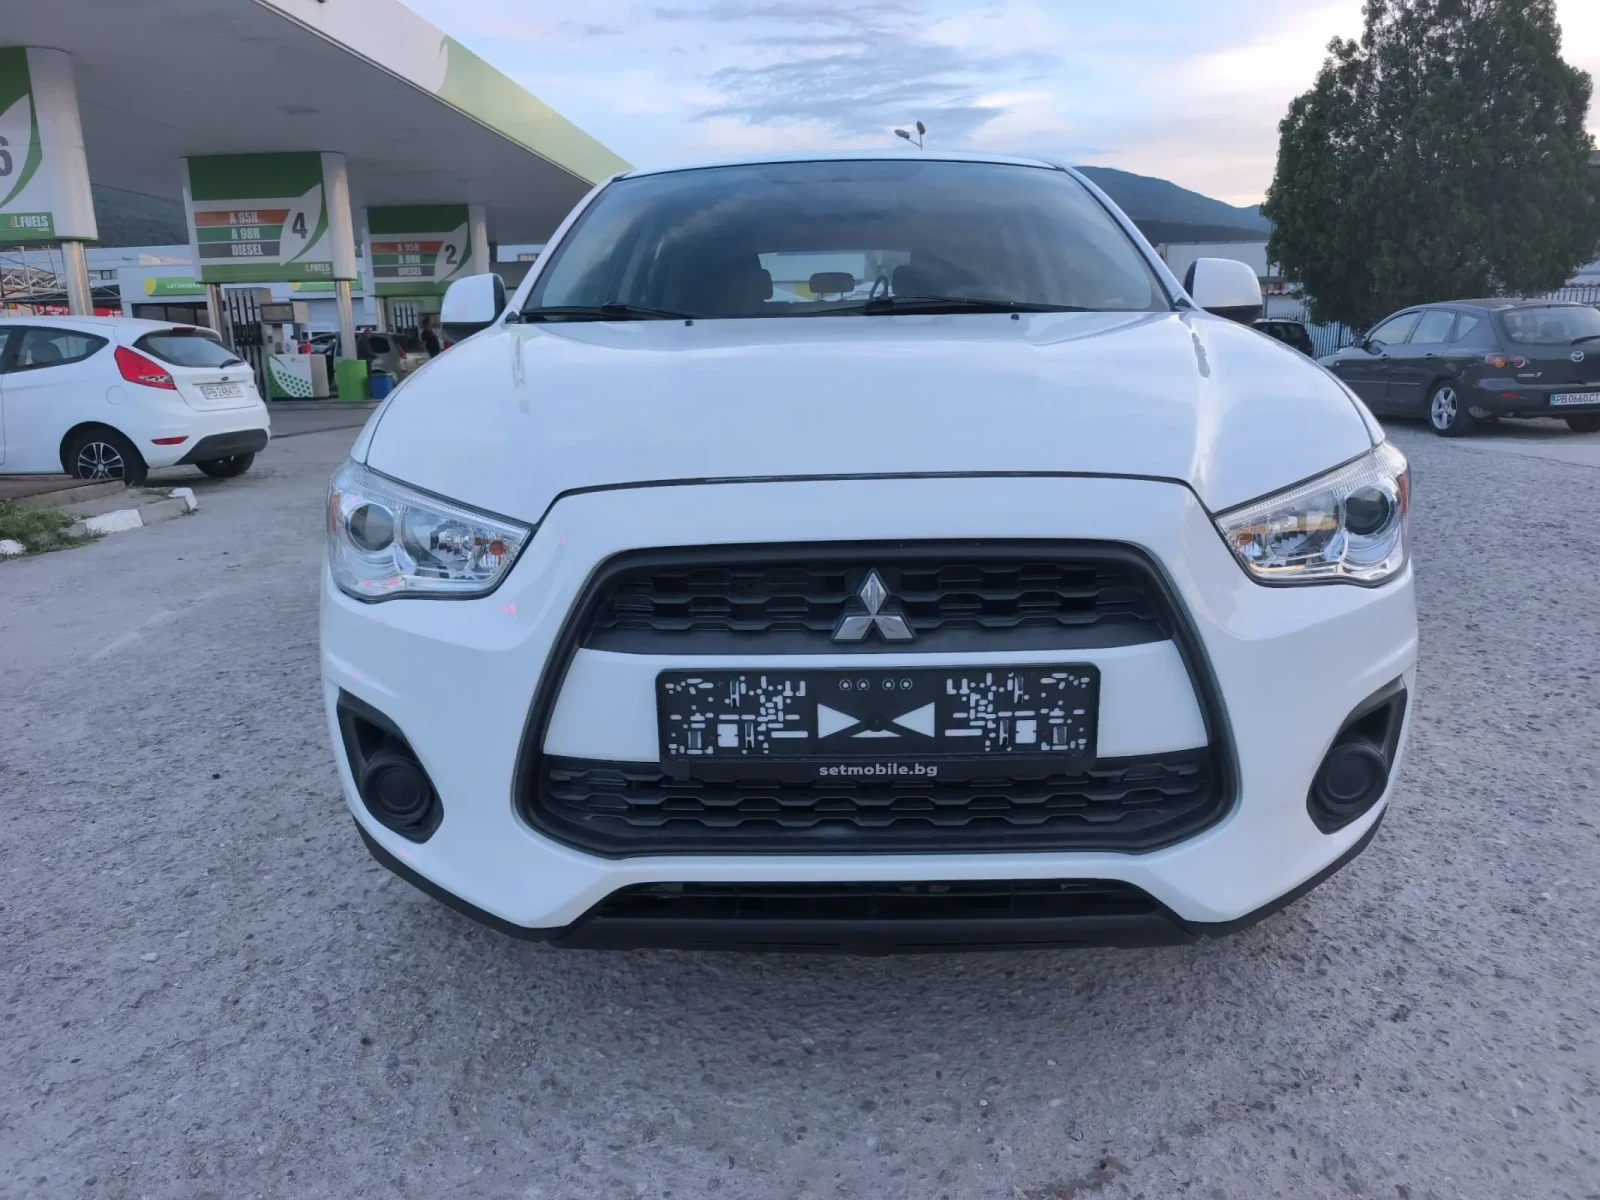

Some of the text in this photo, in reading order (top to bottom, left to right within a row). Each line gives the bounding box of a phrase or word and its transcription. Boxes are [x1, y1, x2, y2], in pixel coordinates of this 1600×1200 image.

[291, 212, 308, 239] 4
[231, 229, 239, 240] A
[231, 243, 264, 256] DIESEL
[444, 244, 458, 265] 2
[398, 266, 422, 276] DIESEL
[819, 763, 938, 777] setmobile.bg
